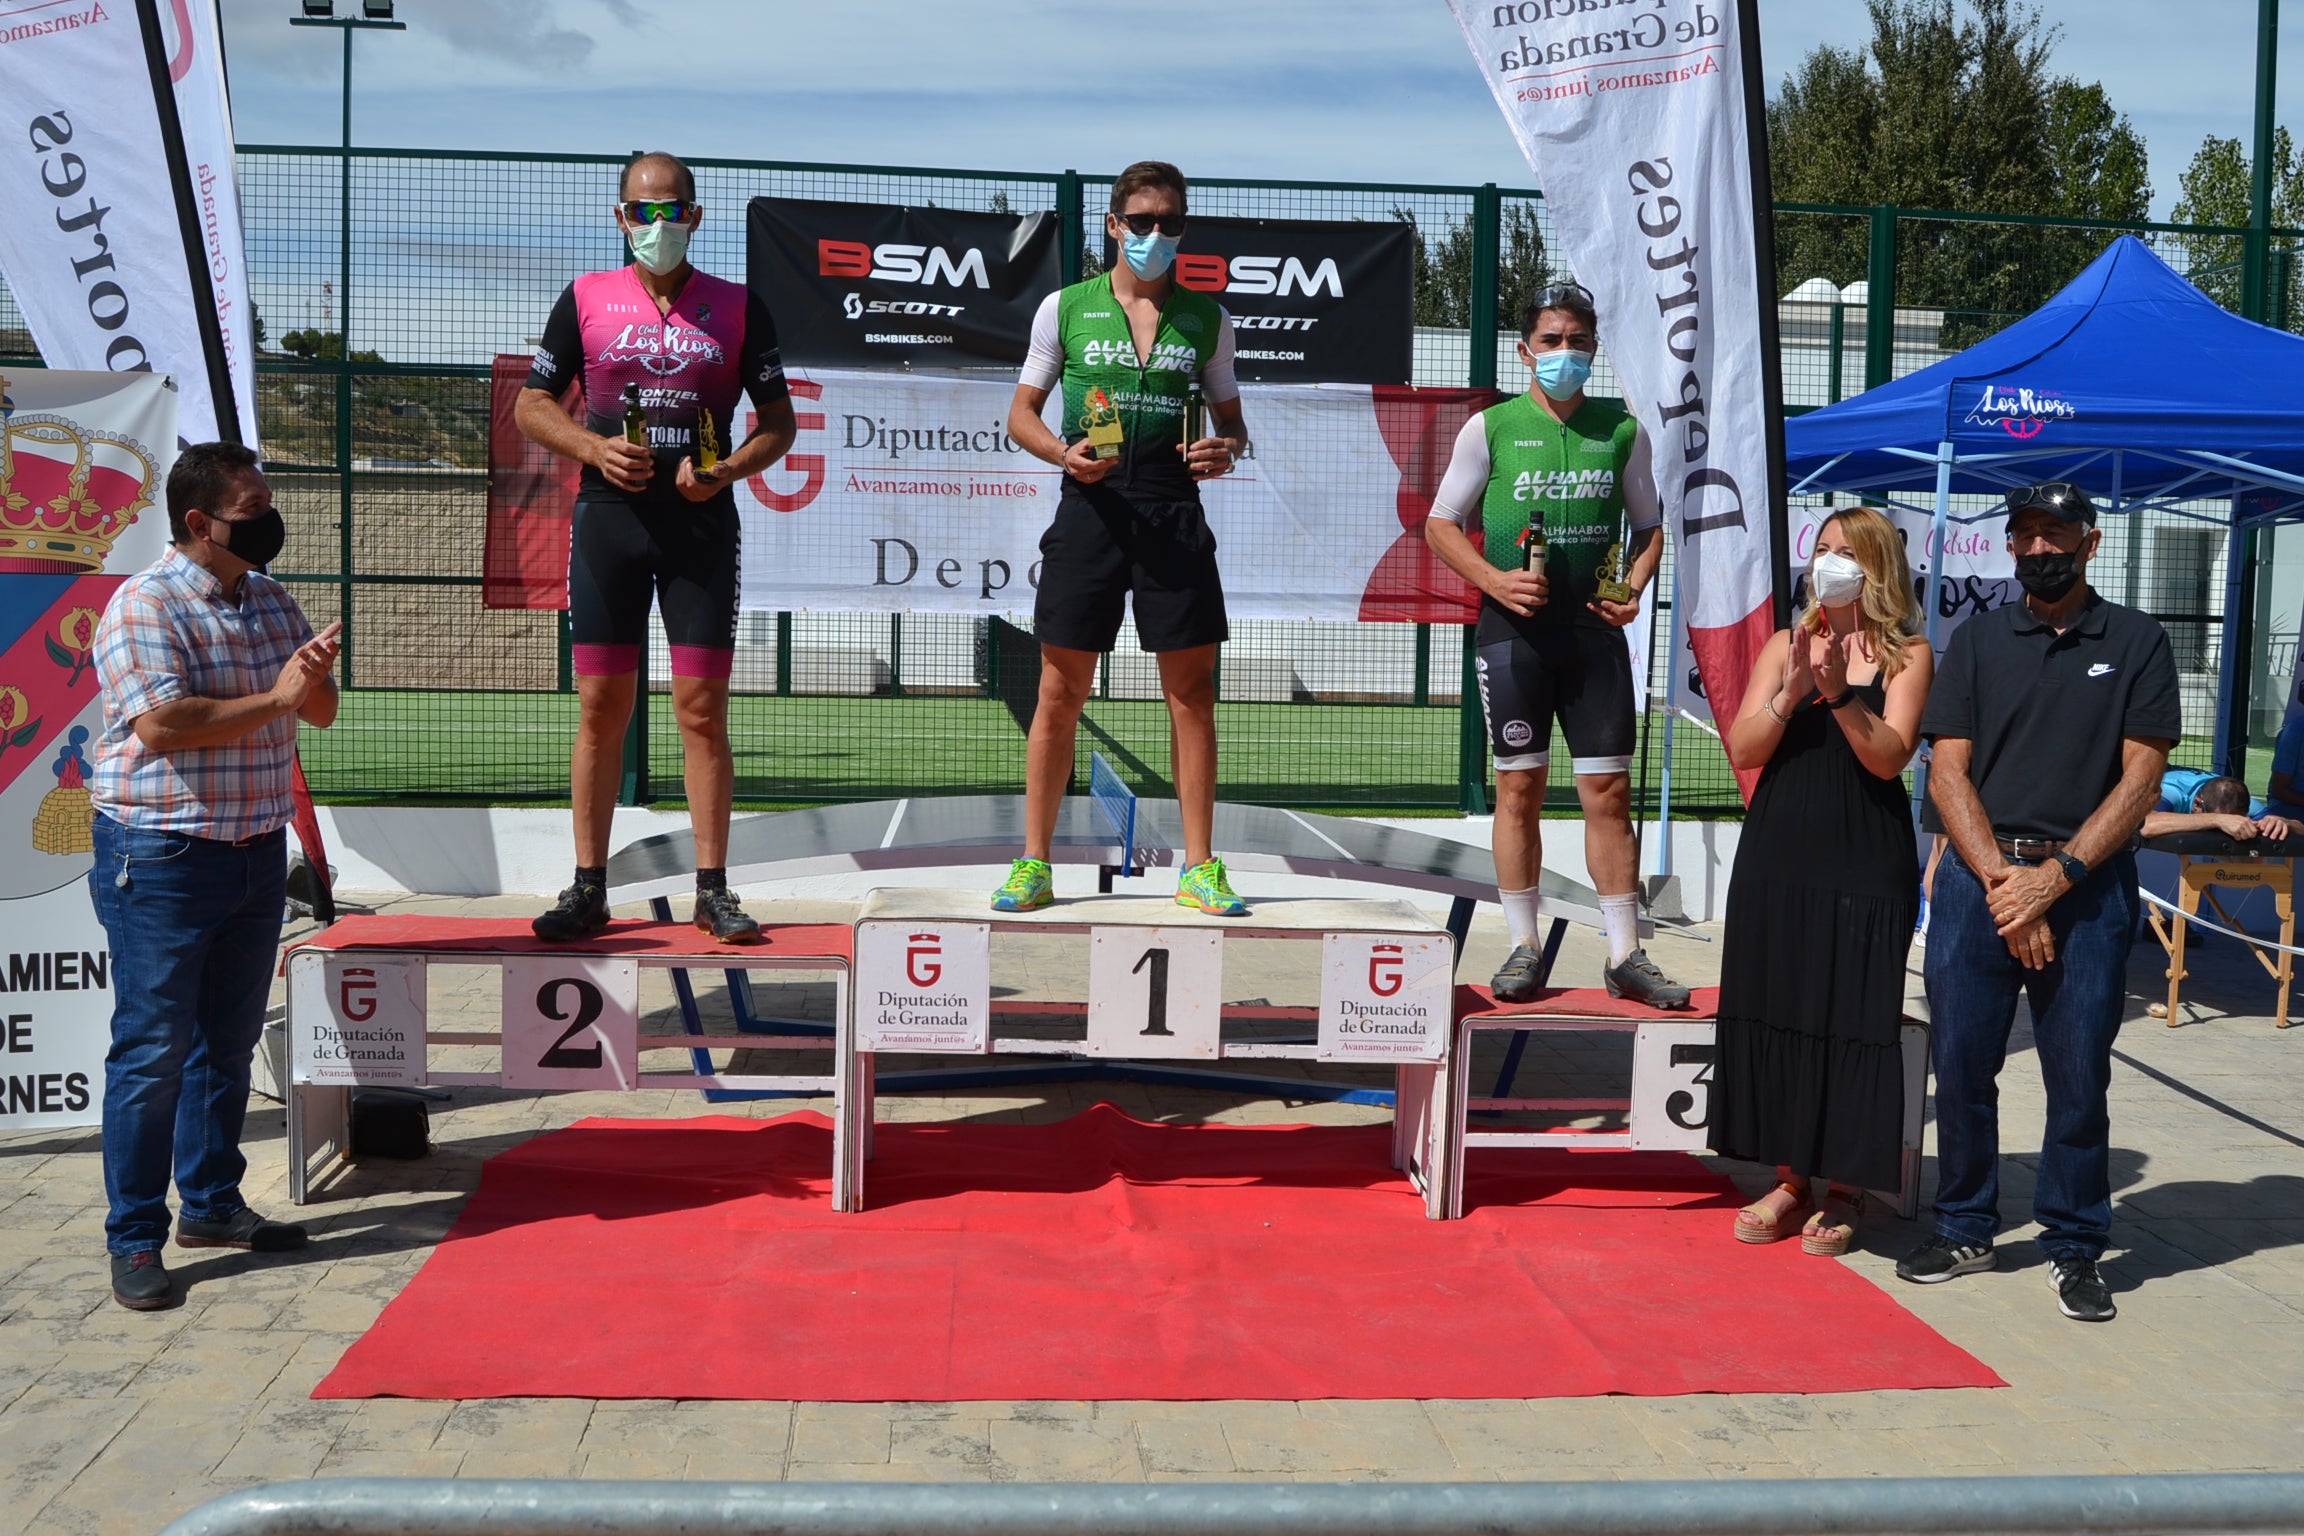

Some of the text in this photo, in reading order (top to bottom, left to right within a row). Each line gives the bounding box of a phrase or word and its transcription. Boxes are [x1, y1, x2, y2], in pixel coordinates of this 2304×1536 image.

[818, 239, 990, 289] BSM
[1176, 253, 1344, 298] BSM
[866, 300, 965, 317] SCOTT
[616, 324, 715, 359] Los Rios
[865, 333, 954, 345] BSMBIKES.COM
[1083, 340, 1197, 360] ALHAMA
[1084, 352, 1195, 373] CYCLING
[640, 397, 680, 408] STIHL
[1112, 391, 1184, 407] ALHAMABOX
[1983, 385, 2019, 415] Los
[646, 426, 691, 444] TORIA
[844, 473, 1038, 499] Avanzamos junt@s
[1514, 469, 1614, 487] ALHAMA
[1513, 483, 1613, 501] CYCLING
[1541, 525, 1610, 537] ALHAMABOX
[2215, 868, 2262, 881] Quirumed
[0, 951, 112, 992] MIEN
[878, 991, 969, 1009] Diputación
[1132, 948, 1175, 1036] 1
[878, 1010, 968, 1026] de Granada
[1340, 1000, 1427, 1018] Diputación
[536, 978, 604, 1069] 2
[1339, 1019, 1426, 1035] de Granada
[0, 1014, 34, 1053] E
[313, 1026, 405, 1044] Diputación
[881, 1034, 966, 1044] Avanzamos junt@s
[313, 1045, 405, 1060] de Granada
[1341, 1042, 1423, 1053] Avanzamos junt@s
[316, 1068, 403, 1079] Avanzamos junt@s
[0, 1072, 90, 1114] NES
[1666, 1043, 1715, 1130] 3
